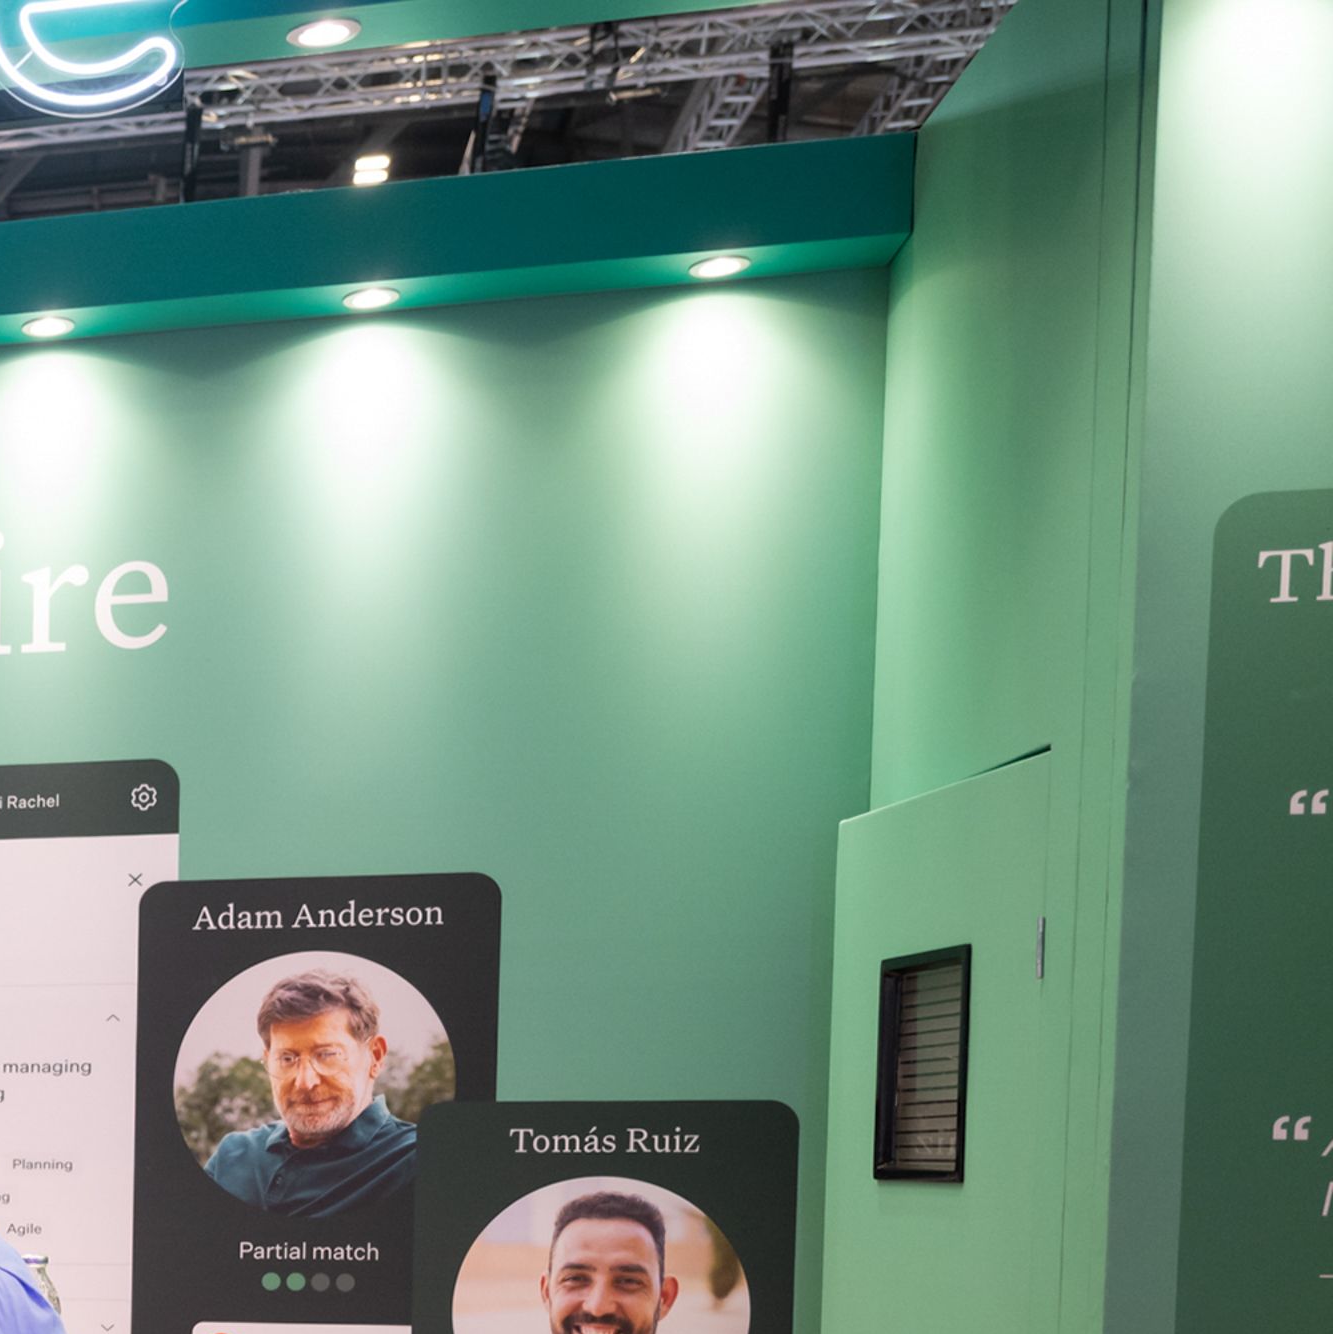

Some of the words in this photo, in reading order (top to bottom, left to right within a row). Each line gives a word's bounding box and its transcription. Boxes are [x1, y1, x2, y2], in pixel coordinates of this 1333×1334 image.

[6, 793, 61, 811] Rachel
[192, 903, 283, 931] Adam
[291, 900, 444, 930] Anderson
[3, 1060, 92, 1077] managing
[509, 1126, 617, 1154] Tomás
[625, 1128, 700, 1154] Ruiz
[12, 1158, 73, 1172] Planning
[6, 1223, 42, 1236] Agile
[239, 1241, 306, 1261] Partial
[312, 1242, 380, 1261] match
